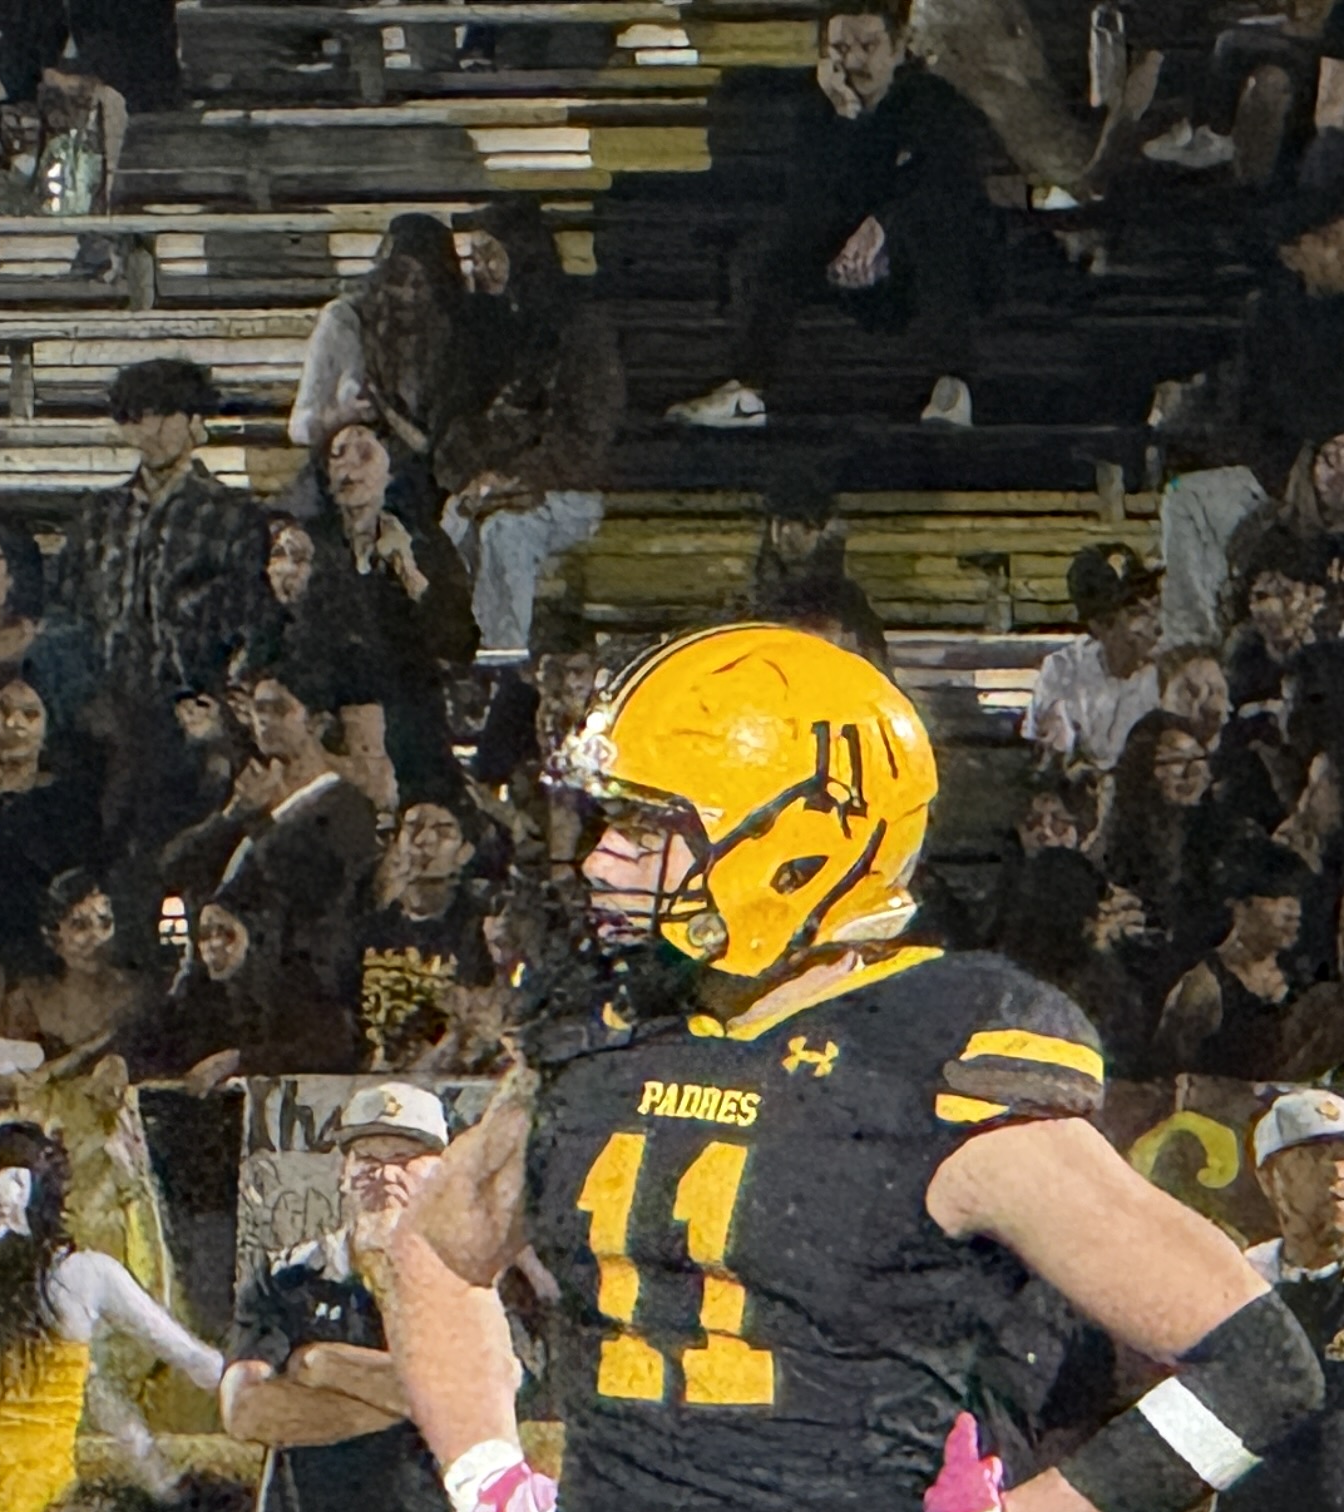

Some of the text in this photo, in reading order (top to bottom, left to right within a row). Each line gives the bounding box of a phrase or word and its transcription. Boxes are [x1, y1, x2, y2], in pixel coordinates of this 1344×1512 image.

[802, 719, 869, 819] 11
[637, 1079, 762, 1127] PADRES
[576, 1132, 775, 1405] 11
